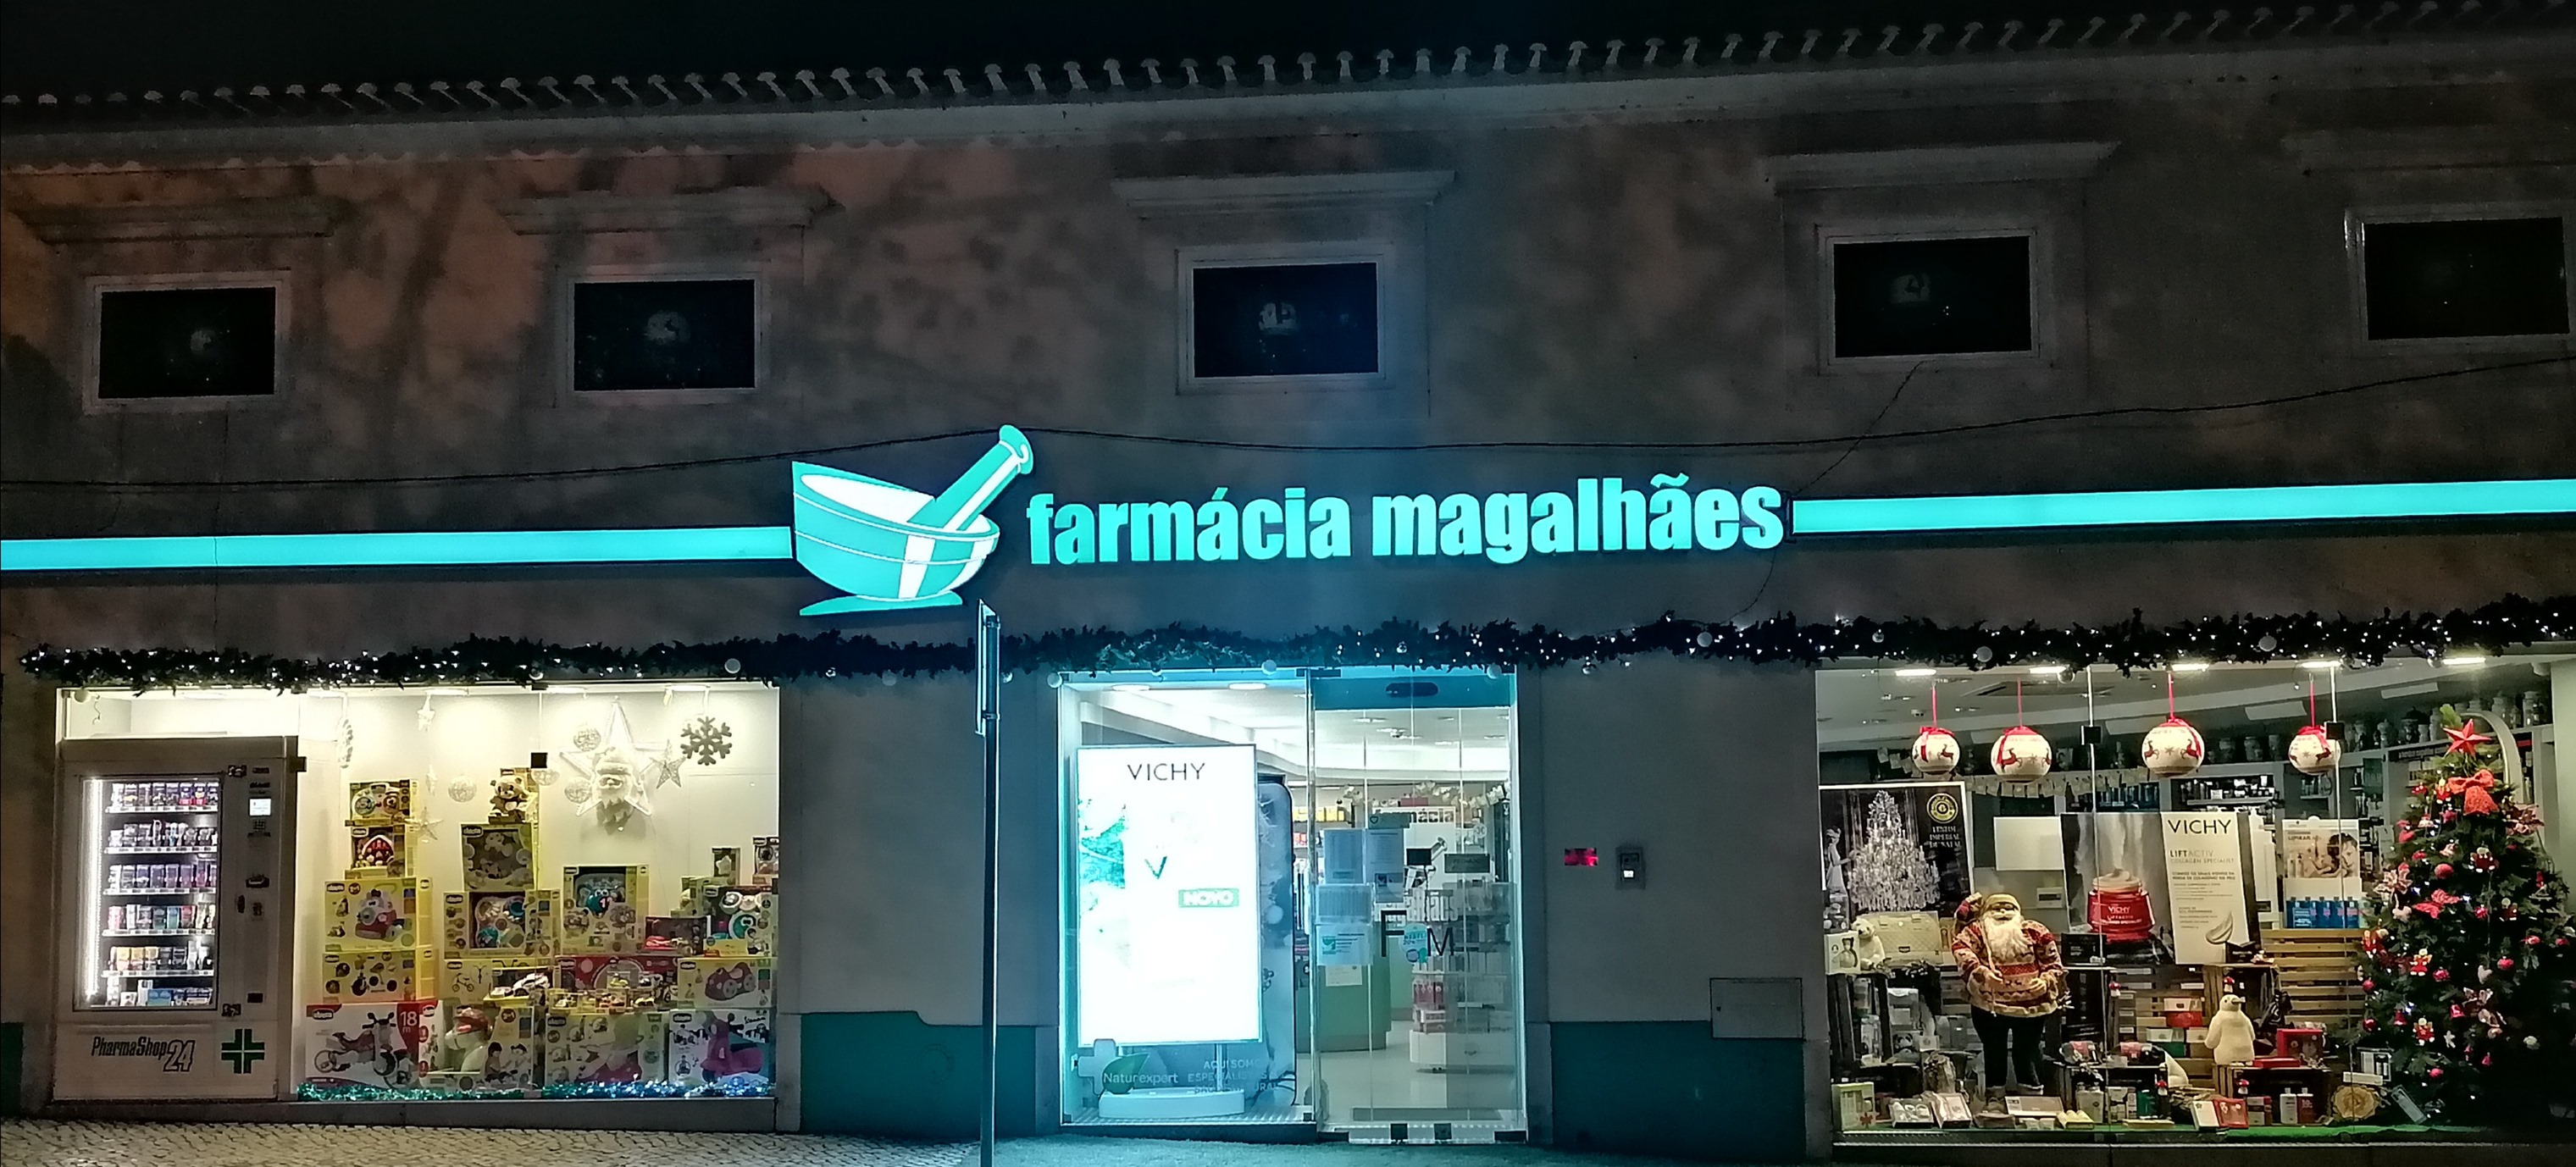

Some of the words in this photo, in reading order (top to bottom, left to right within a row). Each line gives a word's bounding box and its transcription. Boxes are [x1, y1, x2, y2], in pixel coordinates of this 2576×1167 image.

[1027, 487, 1351, 565] farmácia
[1371, 473, 1783, 564] magalhães
[1127, 762, 1205, 781] VICHY
[2167, 819, 2231, 834] VICHY
[401, 1011, 418, 1026] 18
[1104, 1072, 1178, 1085] Naturexpert
